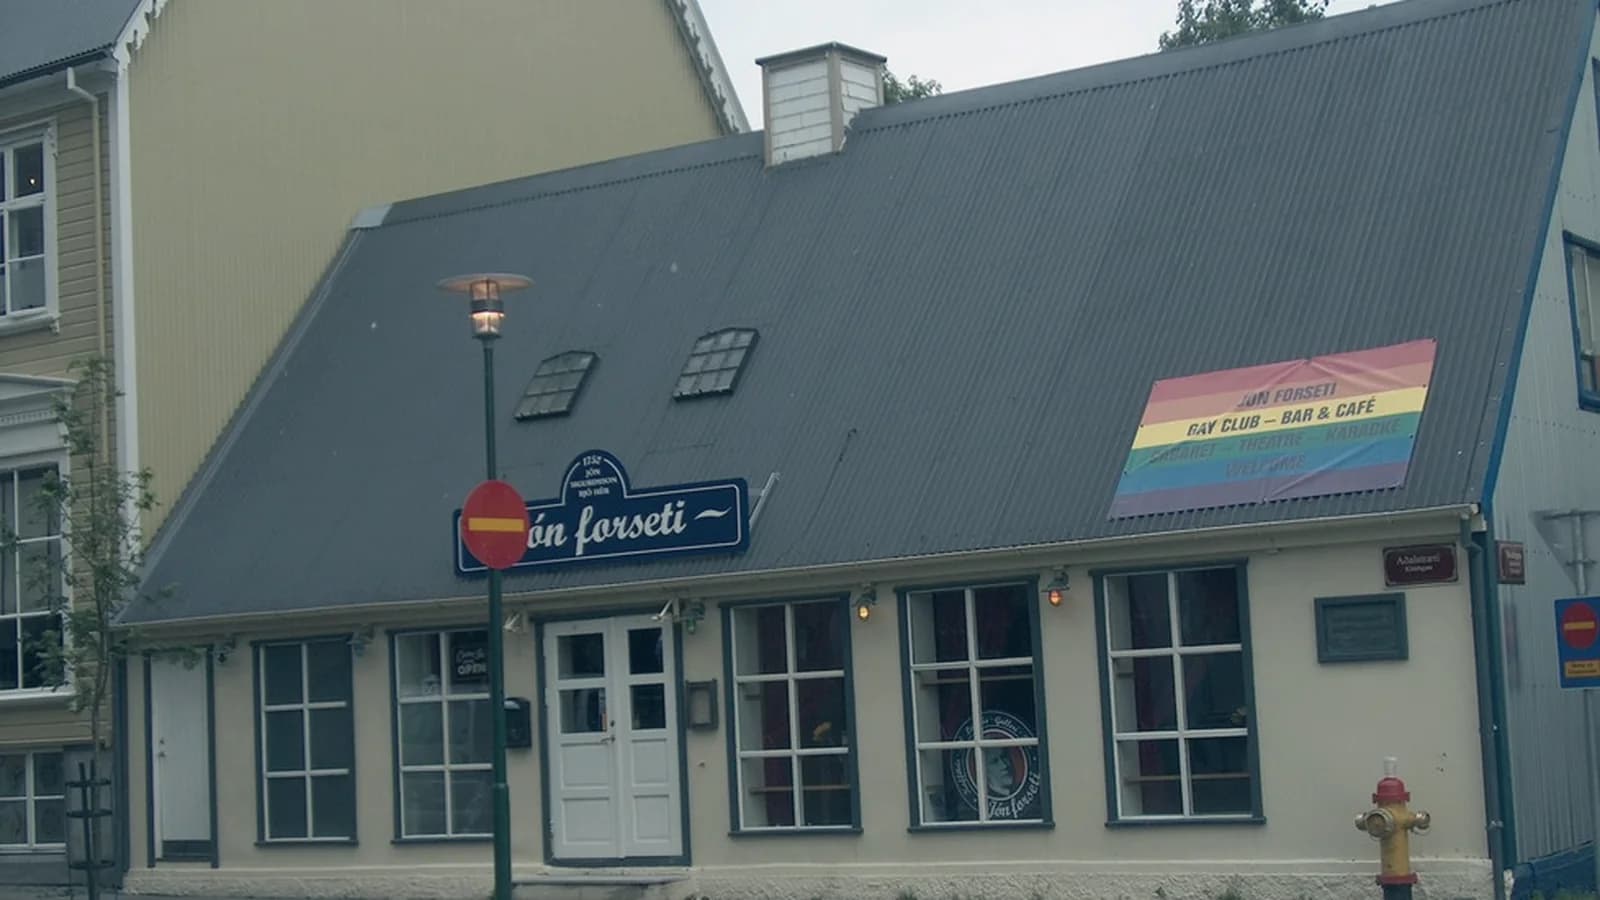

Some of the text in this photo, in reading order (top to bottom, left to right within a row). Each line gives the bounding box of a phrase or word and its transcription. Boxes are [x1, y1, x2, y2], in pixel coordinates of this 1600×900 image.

[1274, 382, 1337, 403] FORSETI
[1186, 419, 1217, 437] GAY
[1221, 415, 1261, 433] CLUB
[1281, 407, 1314, 425] BAR
[1317, 406, 1330, 420] &
[1336, 396, 1376, 418] CAFÉ
[527, 500, 687, 556] ón forseti
